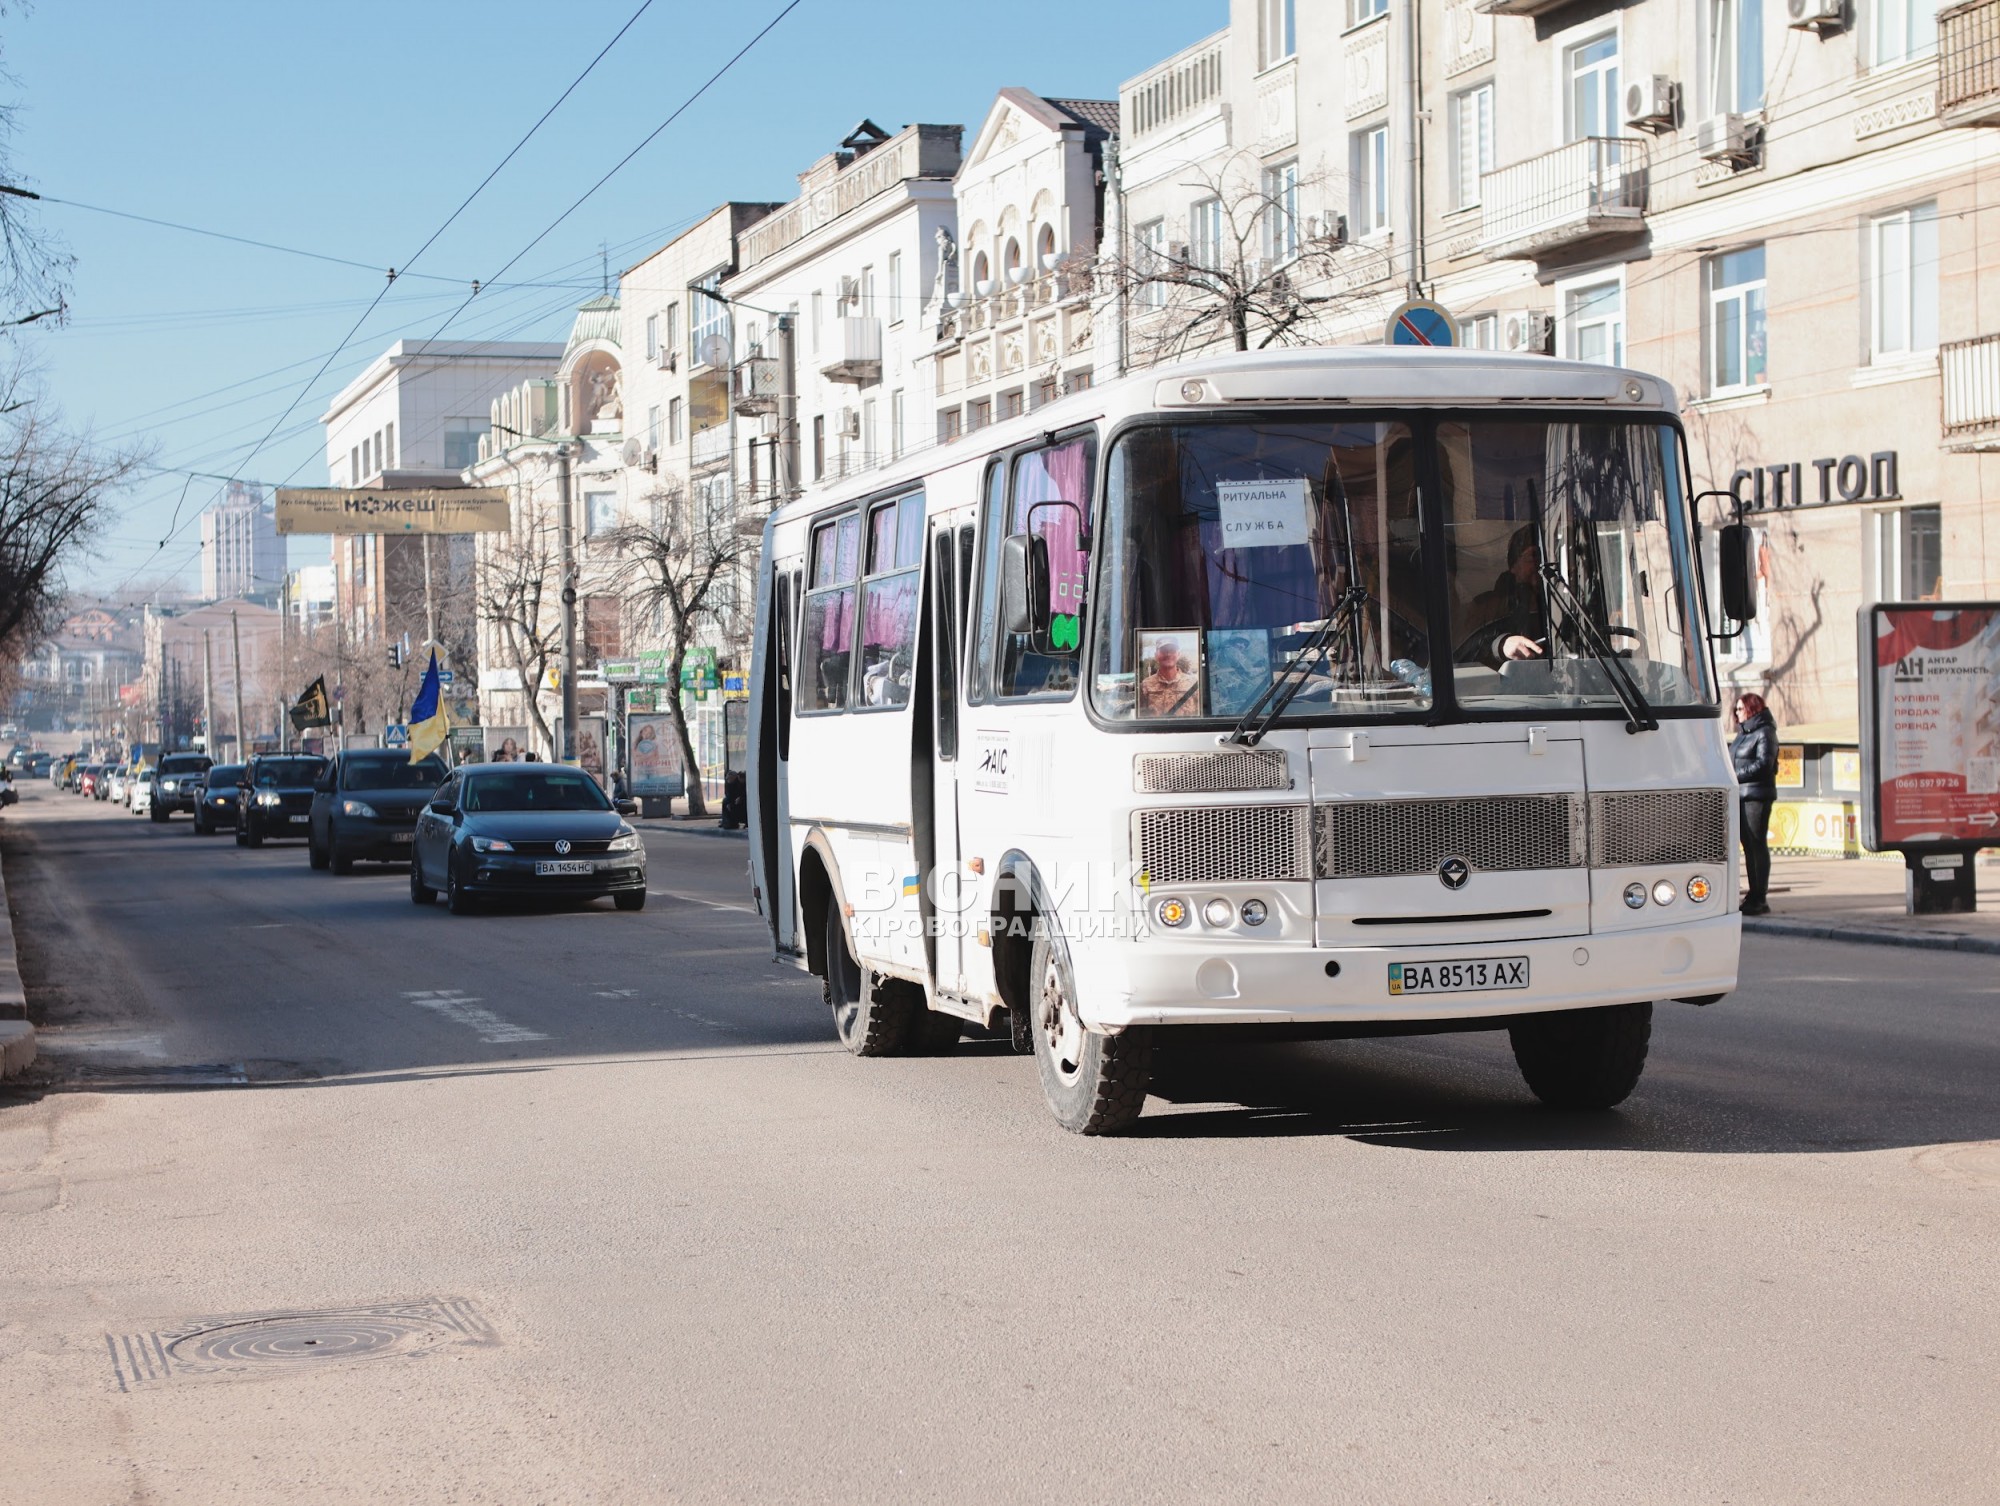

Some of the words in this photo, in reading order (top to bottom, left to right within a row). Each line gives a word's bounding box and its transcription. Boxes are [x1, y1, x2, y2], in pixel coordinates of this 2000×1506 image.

[1729, 462, 1802, 513] СІТІ
[1812, 450, 1899, 503] ТОП
[1223, 490, 1287, 502] РИТУАЛЬНА
[1225, 520, 1284, 532] СЛУЖБА
[1927, 656, 1958, 664] АНТАР
[1894, 657, 1924, 676] АН
[1927, 666, 1989, 675] НЕРУХОМІСТЬ
[1894, 694, 1940, 703] КУПІВЛЯ
[1894, 708, 1940, 717] ПРОДАЖ
[1894, 722, 1937, 731] ОРЕНДА
[1895, 778, 1918, 789] (066)
[1920, 778, 1934, 788] 597
[1936, 778, 1946, 788] 97
[1948, 777, 1959, 787] 26
[542, 863, 555, 873] BA
[558, 863, 577, 873] 1454
[578, 863, 591, 872] HC
[1403, 967, 1435, 990] BA
[1439, 964, 1488, 988] 8513
[1493, 961, 1523, 985] AX
